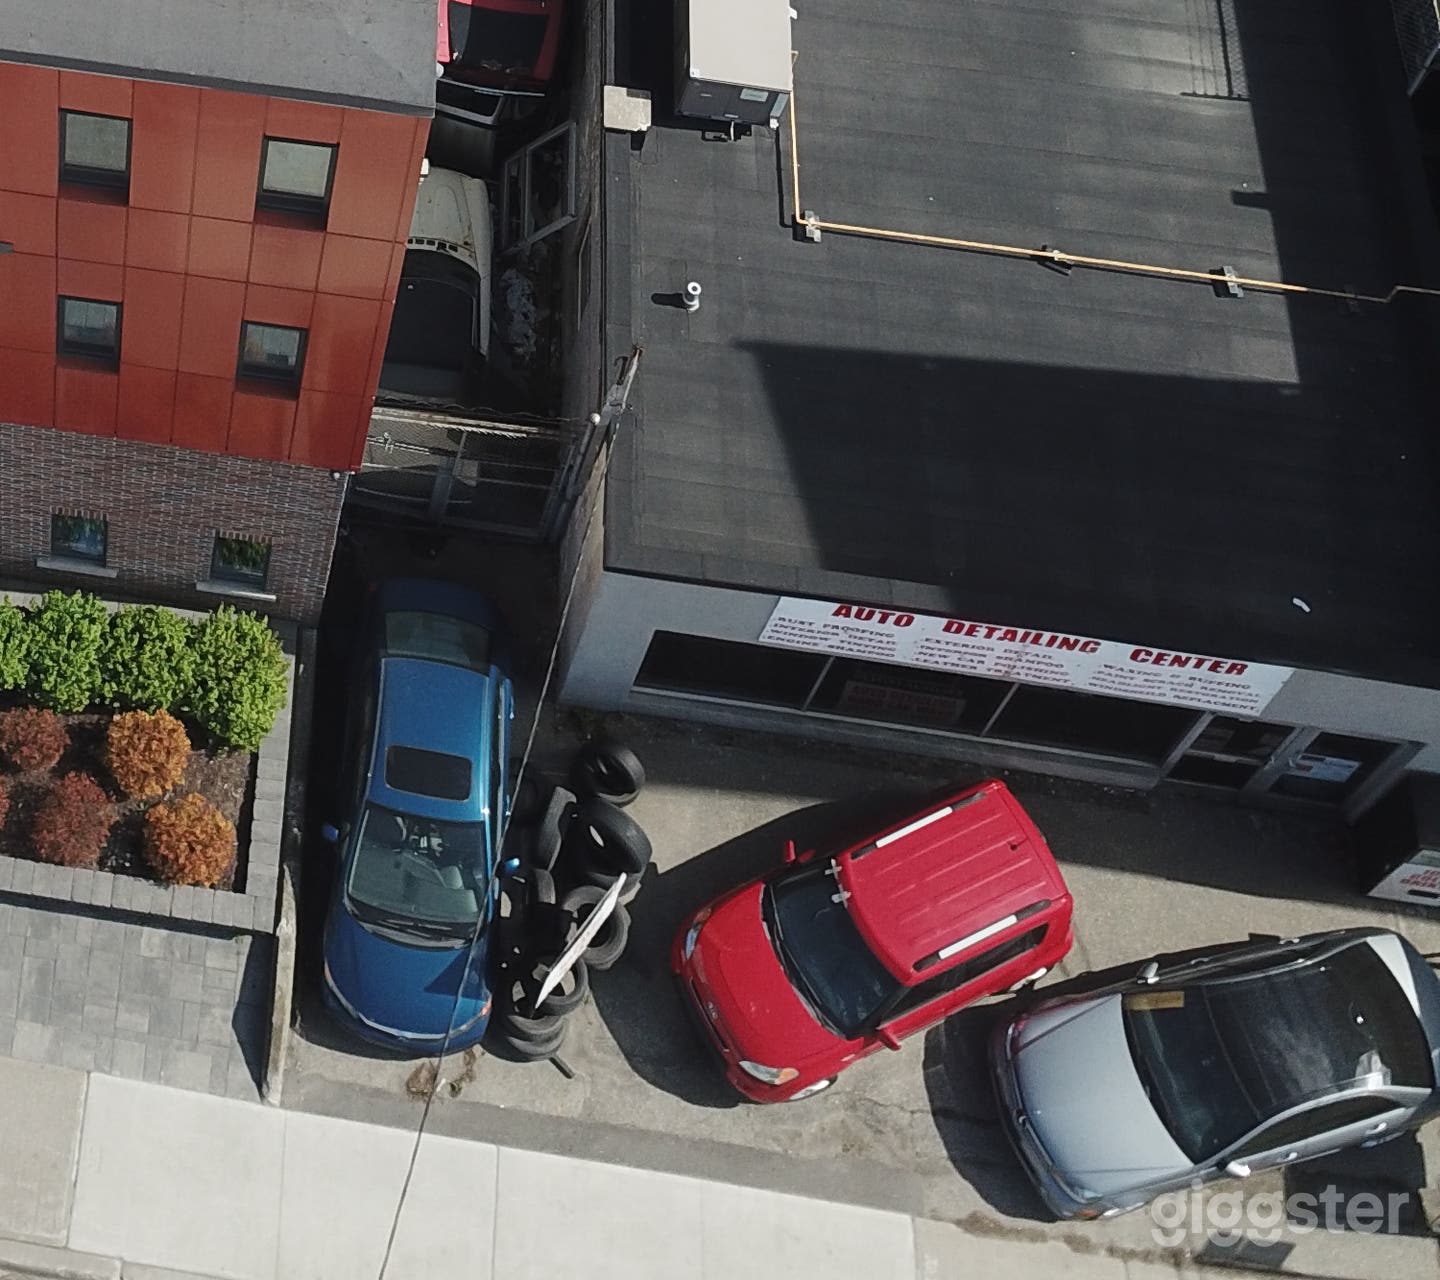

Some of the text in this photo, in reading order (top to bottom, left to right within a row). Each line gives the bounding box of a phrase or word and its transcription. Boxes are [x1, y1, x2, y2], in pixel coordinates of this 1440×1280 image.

[778, 616, 895, 638] RUST PROOFING
[832, 605, 1248, 675] AUTO DETAILING CENTER
[925, 638, 995, 652] EXTERIOR
[917, 651, 950, 659] NEW
